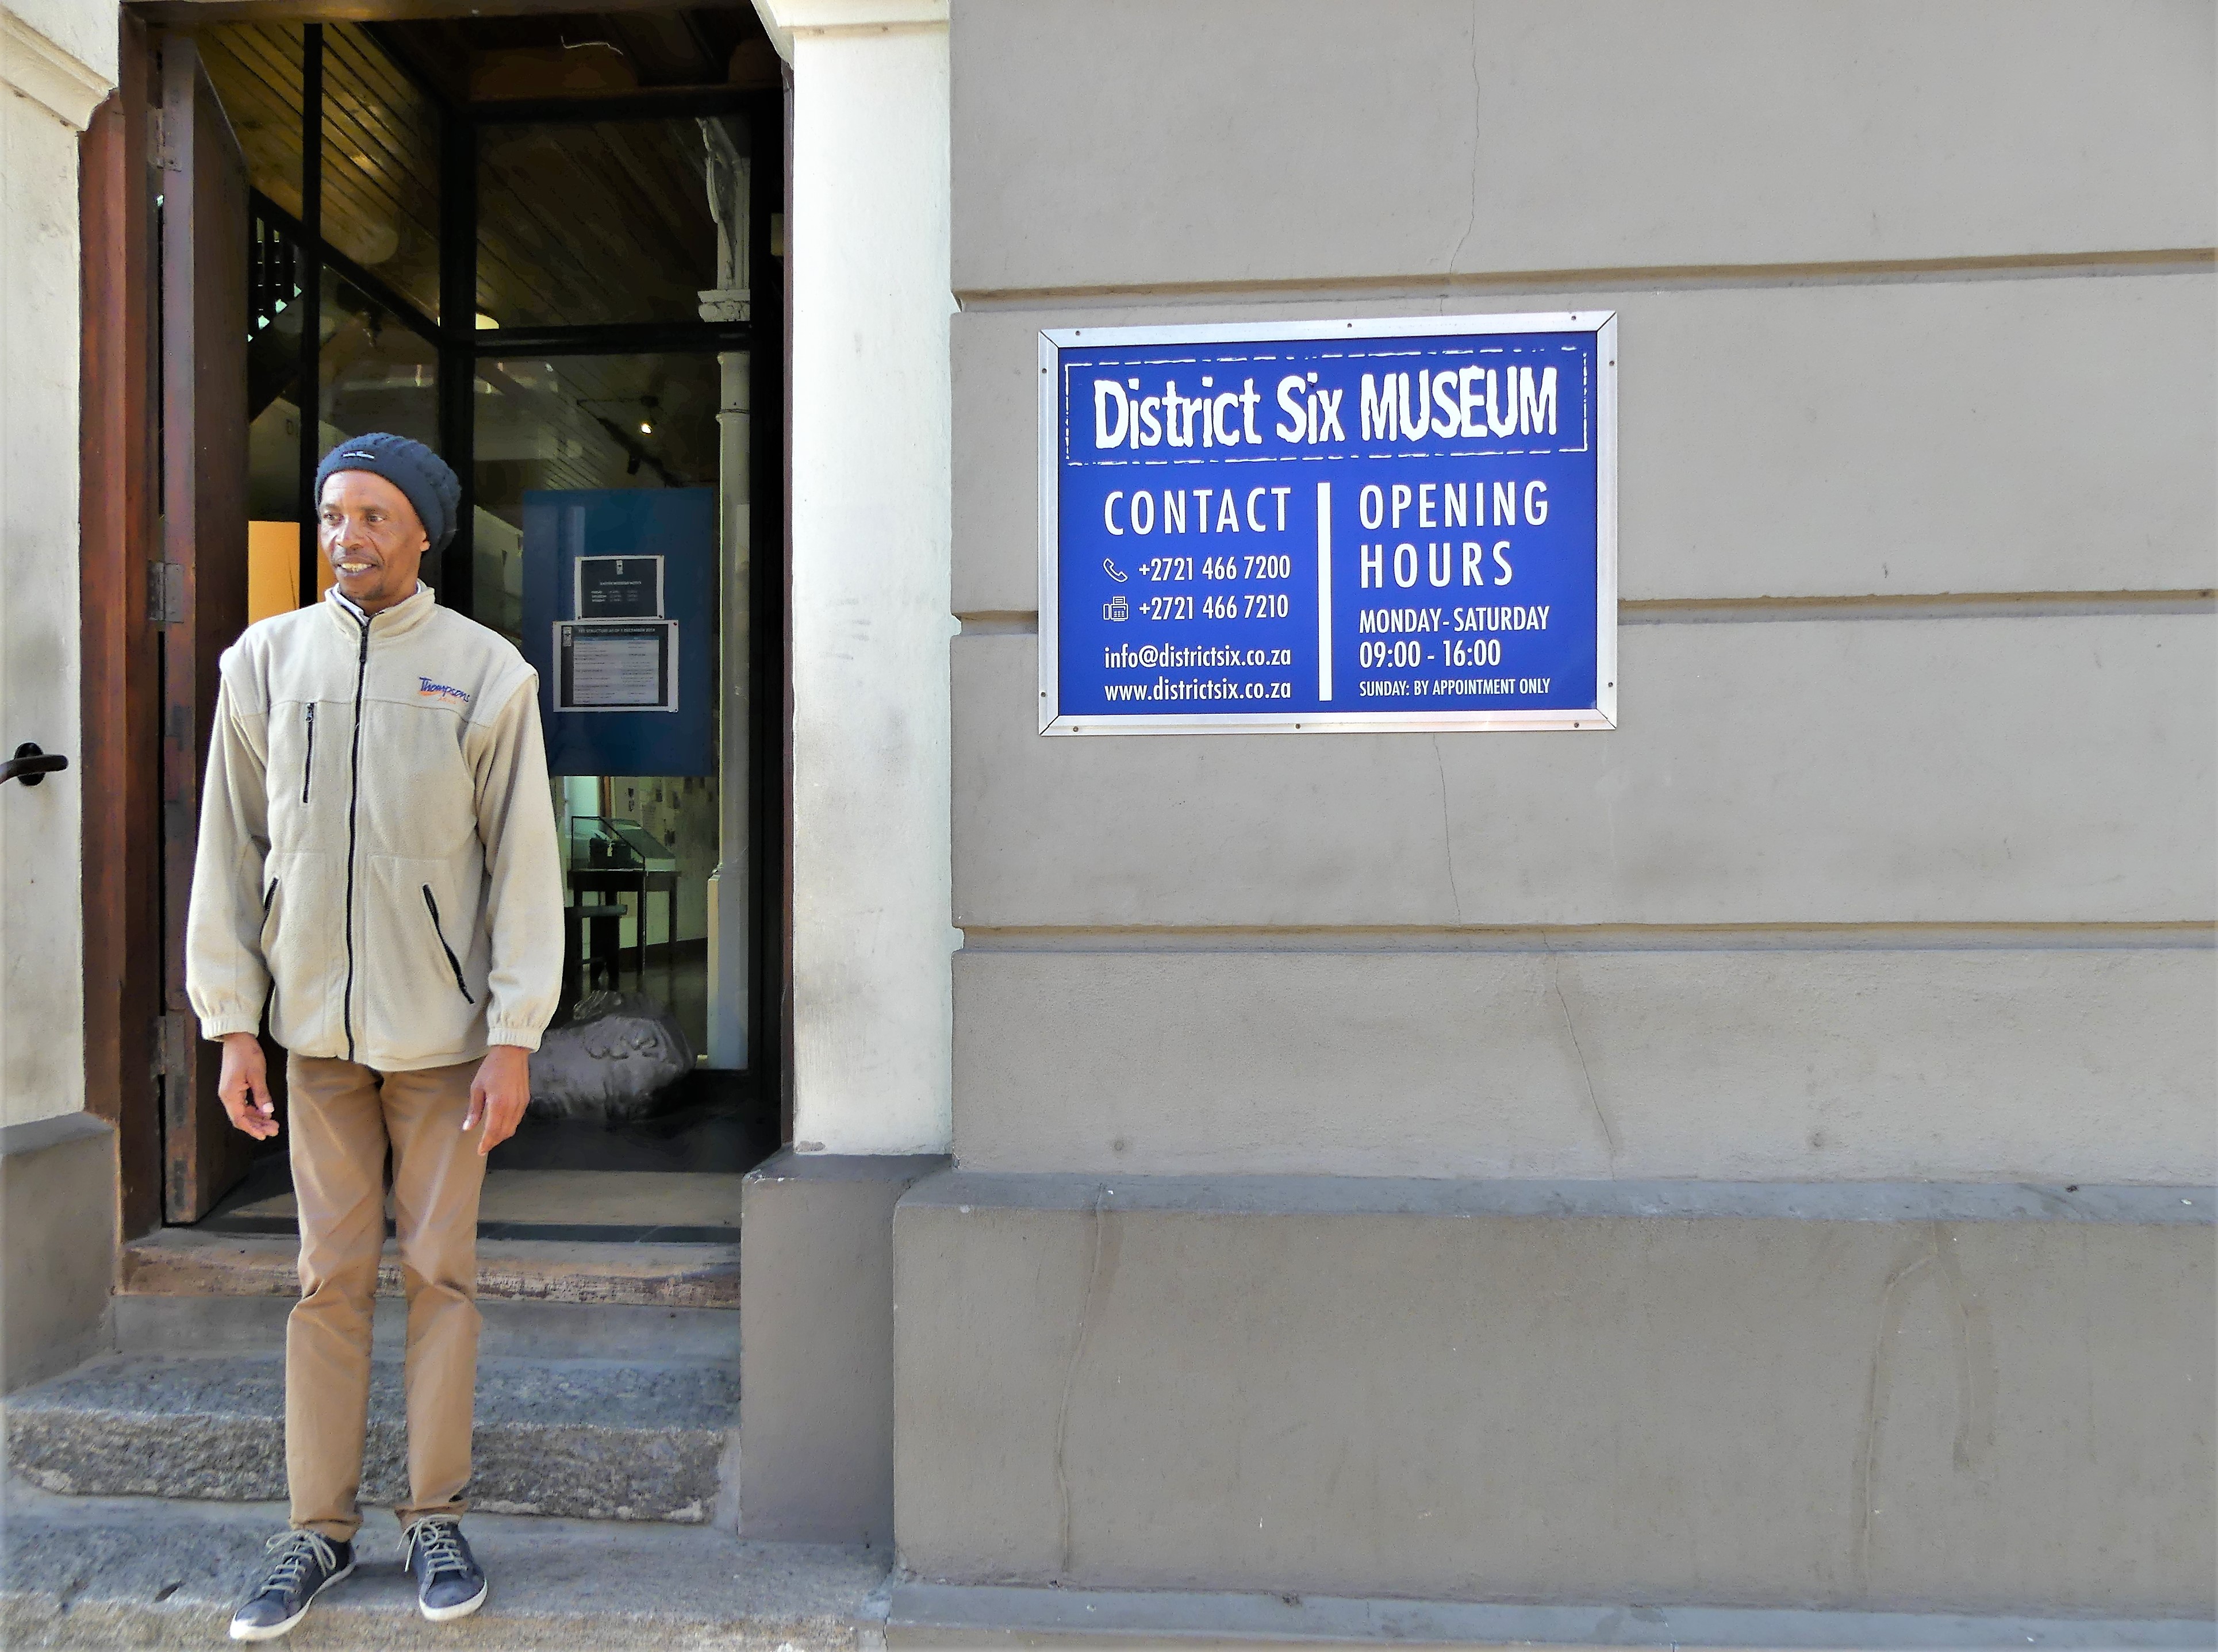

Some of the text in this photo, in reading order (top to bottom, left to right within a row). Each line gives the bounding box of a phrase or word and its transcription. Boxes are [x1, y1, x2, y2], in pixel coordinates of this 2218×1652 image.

[1093, 364, 1558, 450] District Six MUSEUM
[1104, 487, 1291, 536] CONTACT
[1359, 480, 1548, 529] OPENING
[1138, 555, 1291, 581] +2721 466 7200
[1361, 540, 1513, 589] HOURS
[1139, 594, 1288, 620] +2721 466 7210
[1104, 643, 1291, 669] info@districtsix.co.za
[1360, 640, 1421, 668] 09:00
[1442, 639, 1501, 667] 16:00
[419, 677, 470, 702] Thompsons
[1104, 676, 1291, 701] www.districtsix.co.za
[1359, 678, 1551, 697] SUNDAY: BY APPOINTMENT ONLY
